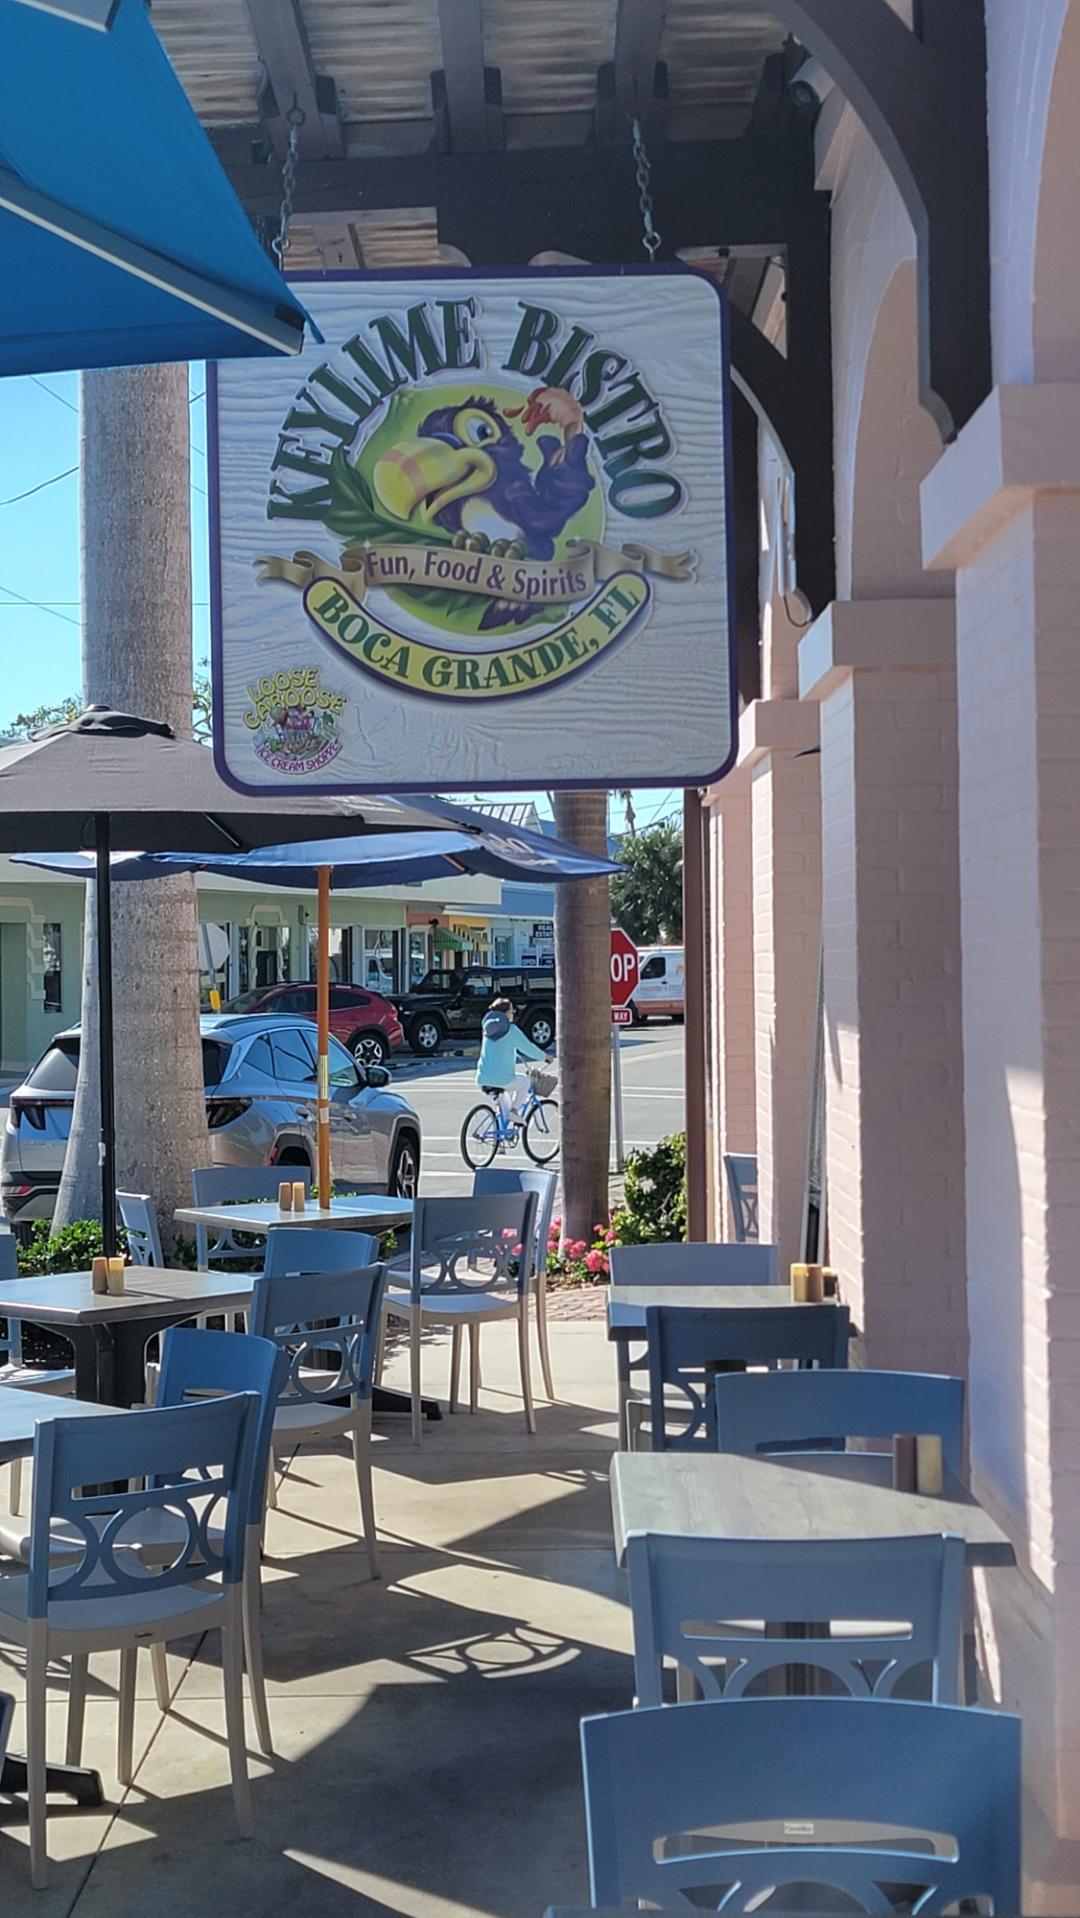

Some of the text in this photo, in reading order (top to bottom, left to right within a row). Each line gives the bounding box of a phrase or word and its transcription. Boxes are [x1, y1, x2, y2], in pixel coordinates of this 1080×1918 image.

[267, 297, 681, 520] KEYLIME BISTRO
[365, 551, 586, 599] Fun, Food & Spirits
[312, 585, 641, 690] BOCA GRANDE, FL
[242, 686, 347, 731] CABOOSE
[246, 667, 319, 705] LOOSE
[257, 742, 339, 771] ICE CREAM SHOPPE
[610, 953, 636, 982] OP
